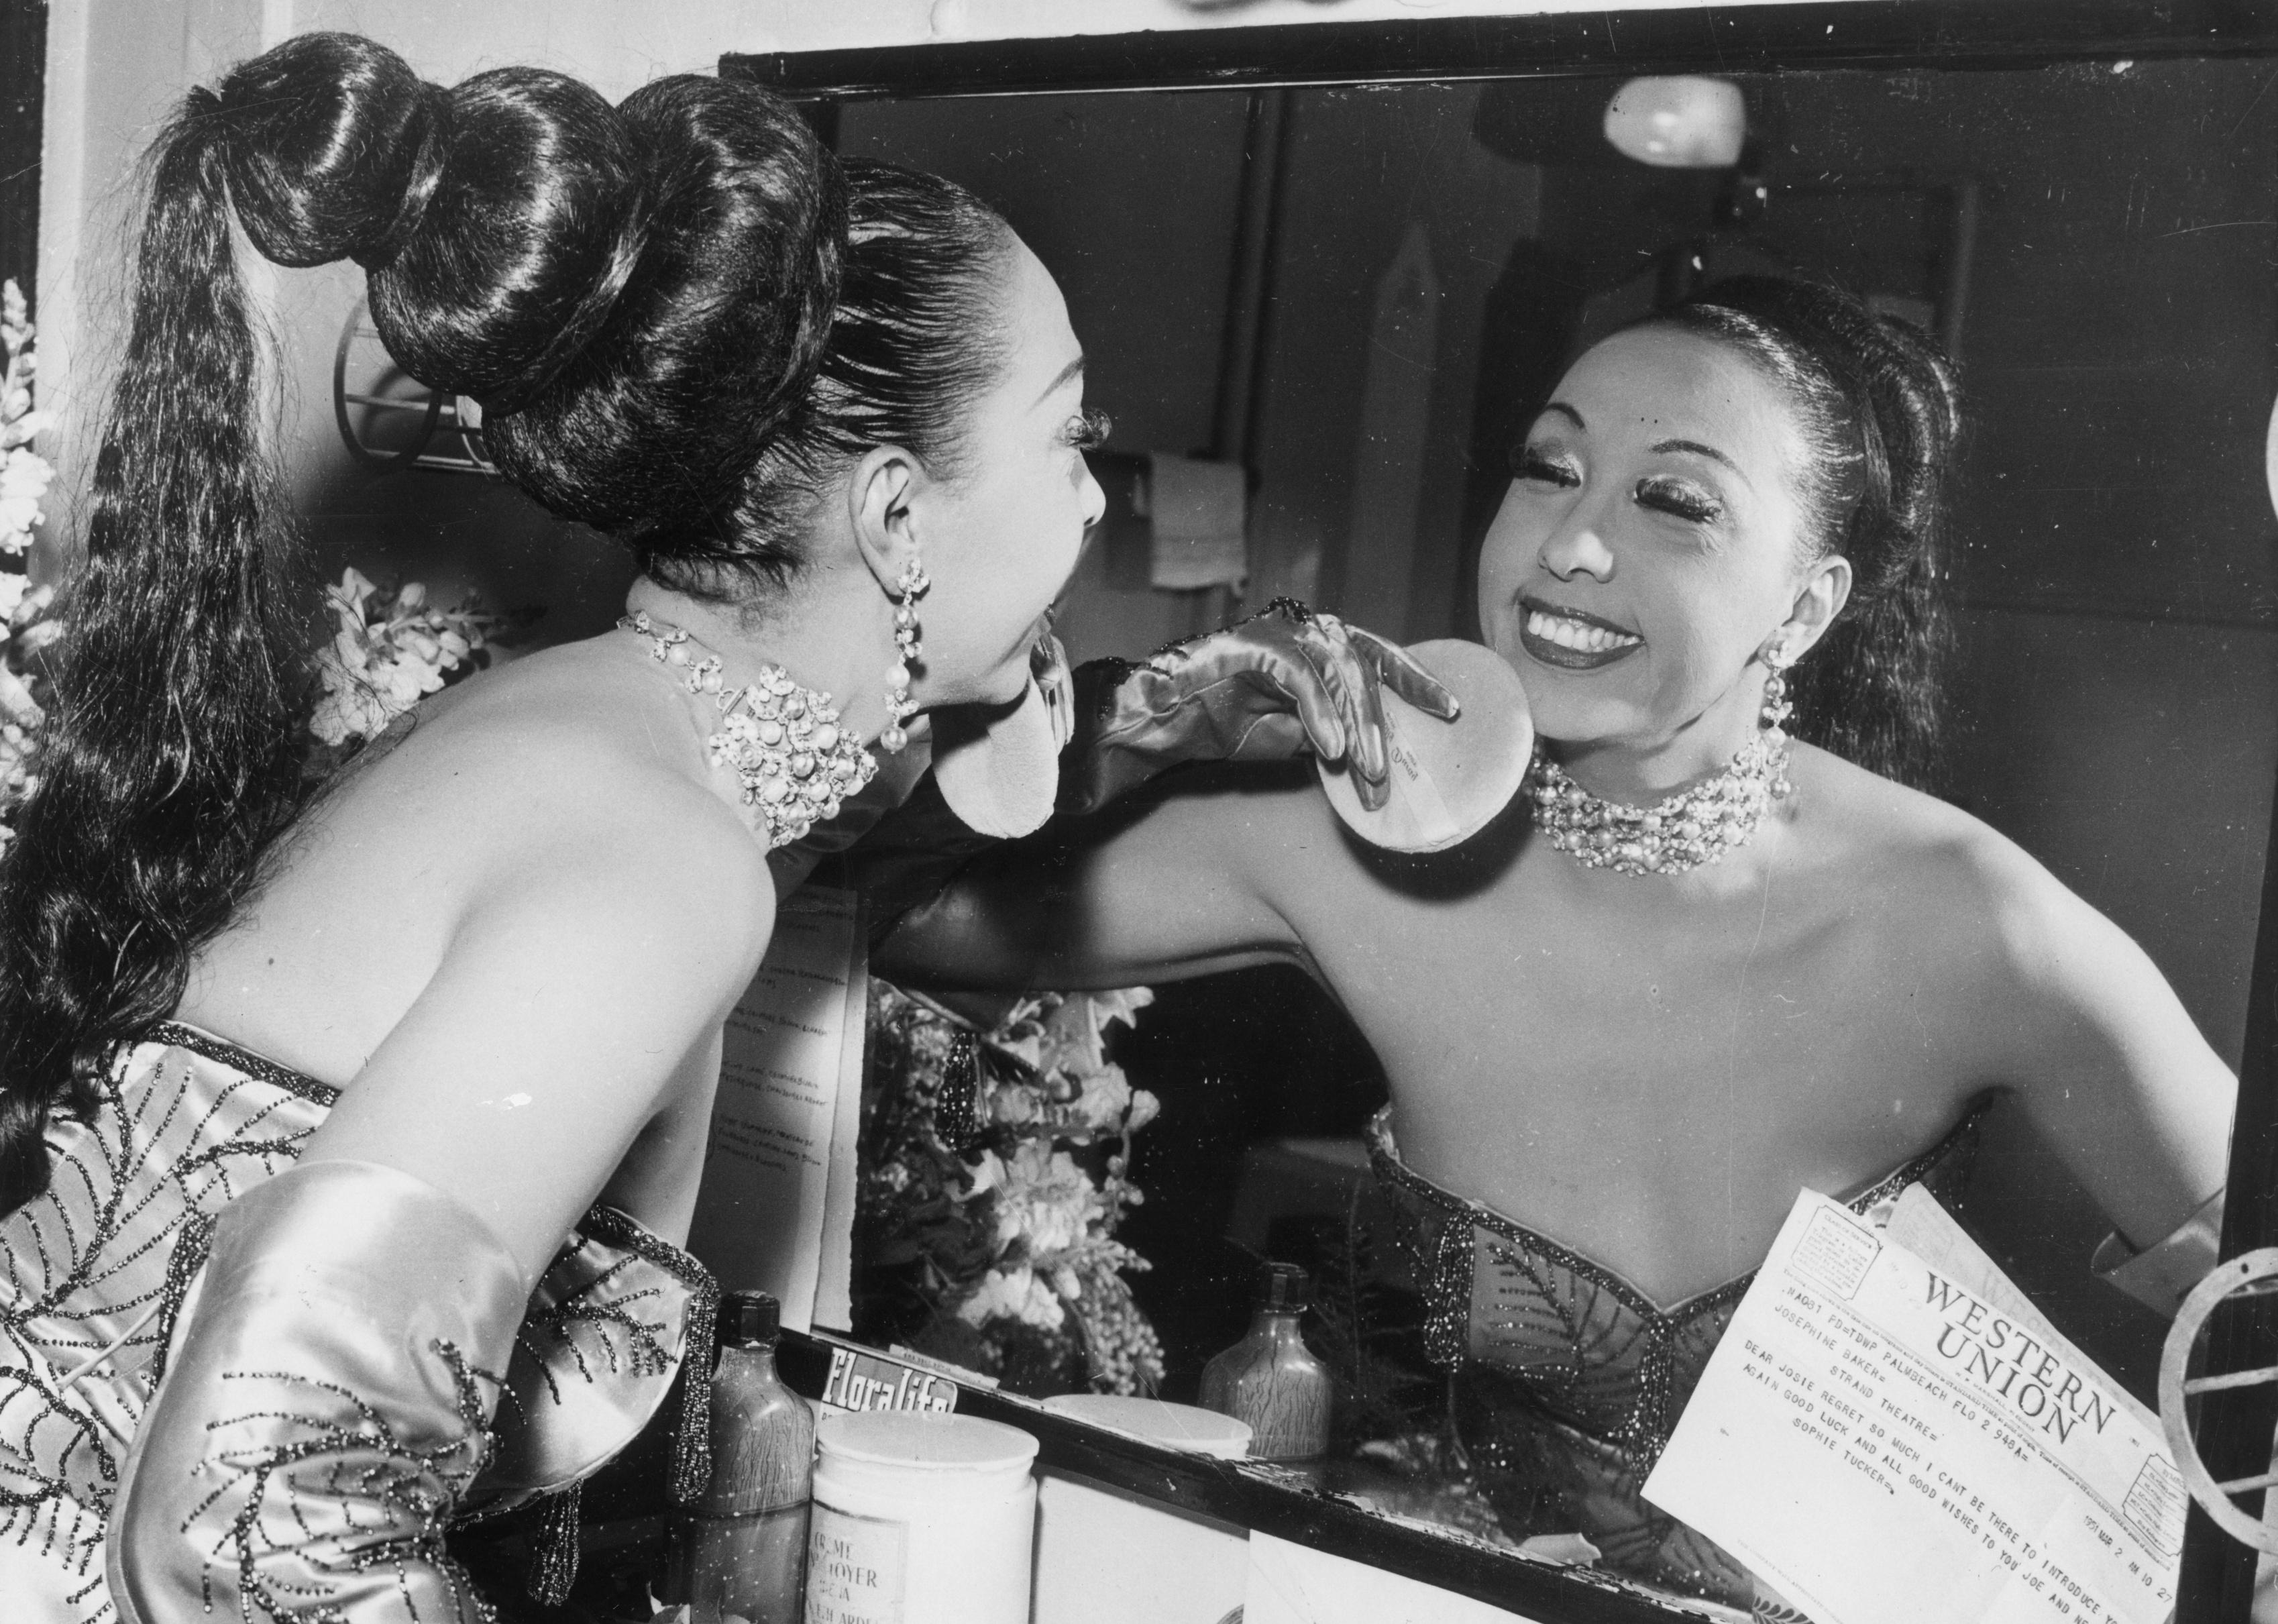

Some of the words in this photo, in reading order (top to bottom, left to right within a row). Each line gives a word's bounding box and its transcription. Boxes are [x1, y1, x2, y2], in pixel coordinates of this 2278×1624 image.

[1774, 1304, 1837, 1351] JOSEPHINE
[1842, 1349, 1886, 1383] BAKER=
[1827, 1314, 1878, 1351] PD=TDWP
[1882, 1352, 1948, 1401] PALMBEACH
[1952, 1400, 1975, 1421] FLO
[1980, 1419, 1990, 1431] 2
[1926, 1271, 2117, 1435] WESTERN
[1937, 1322, 2078, 1445] UNION
[1792, 1417, 1837, 1450] SOPHIE
[1829, 1365, 1874, 1399] STRAND
[1880, 1398, 1938, 1442] THEATRE=
[1743, 1363, 1778, 1391] AGAIN
[1784, 1389, 1814, 1413] GOOD
[1820, 1411, 1849, 1436] LUCK
[1854, 1436, 1877, 1454] AND
[1882, 1454, 1902, 1475] ALL
[1908, 1474, 1937, 1499] GOOD
[1941, 1498, 1979, 1535] WISHES
[1982, 1533, 1995, 1550] TO
[2000, 1550, 2021, 1571] YOU
[2022, 1572, 2045, 1592] JOE
[2048, 1593, 2070, 1614] AND
[1744, 1340, 1774, 1364] DEAR
[1778, 1364, 1814, 1391] JOSIE
[1820, 1390, 1865, 1424] REGRET
[1869, 1423, 1885, 1438] SO
[1891, 1437, 1920, 1462] MUCH
[1926, 1462, 1933, 1472] I
[1938, 1472, 1967, 1496] CANT
[1969, 1495, 1985, 1513] BE
[1988, 1511, 2020, 1544] THERE
[2022, 1542, 2037, 1560] TO
[2041, 1560, 2101, 1615] INTRODUCE
[2083, 1515, 2100, 1533] 1951
[2098, 1529, 2114, 1547] MAR
[2114, 1547, 2123, 1558] 2
[2128, 1561, 2140, 1575] AM
[2141, 1573, 2153, 1587] 10
[2157, 1587, 2173, 1602] 27
